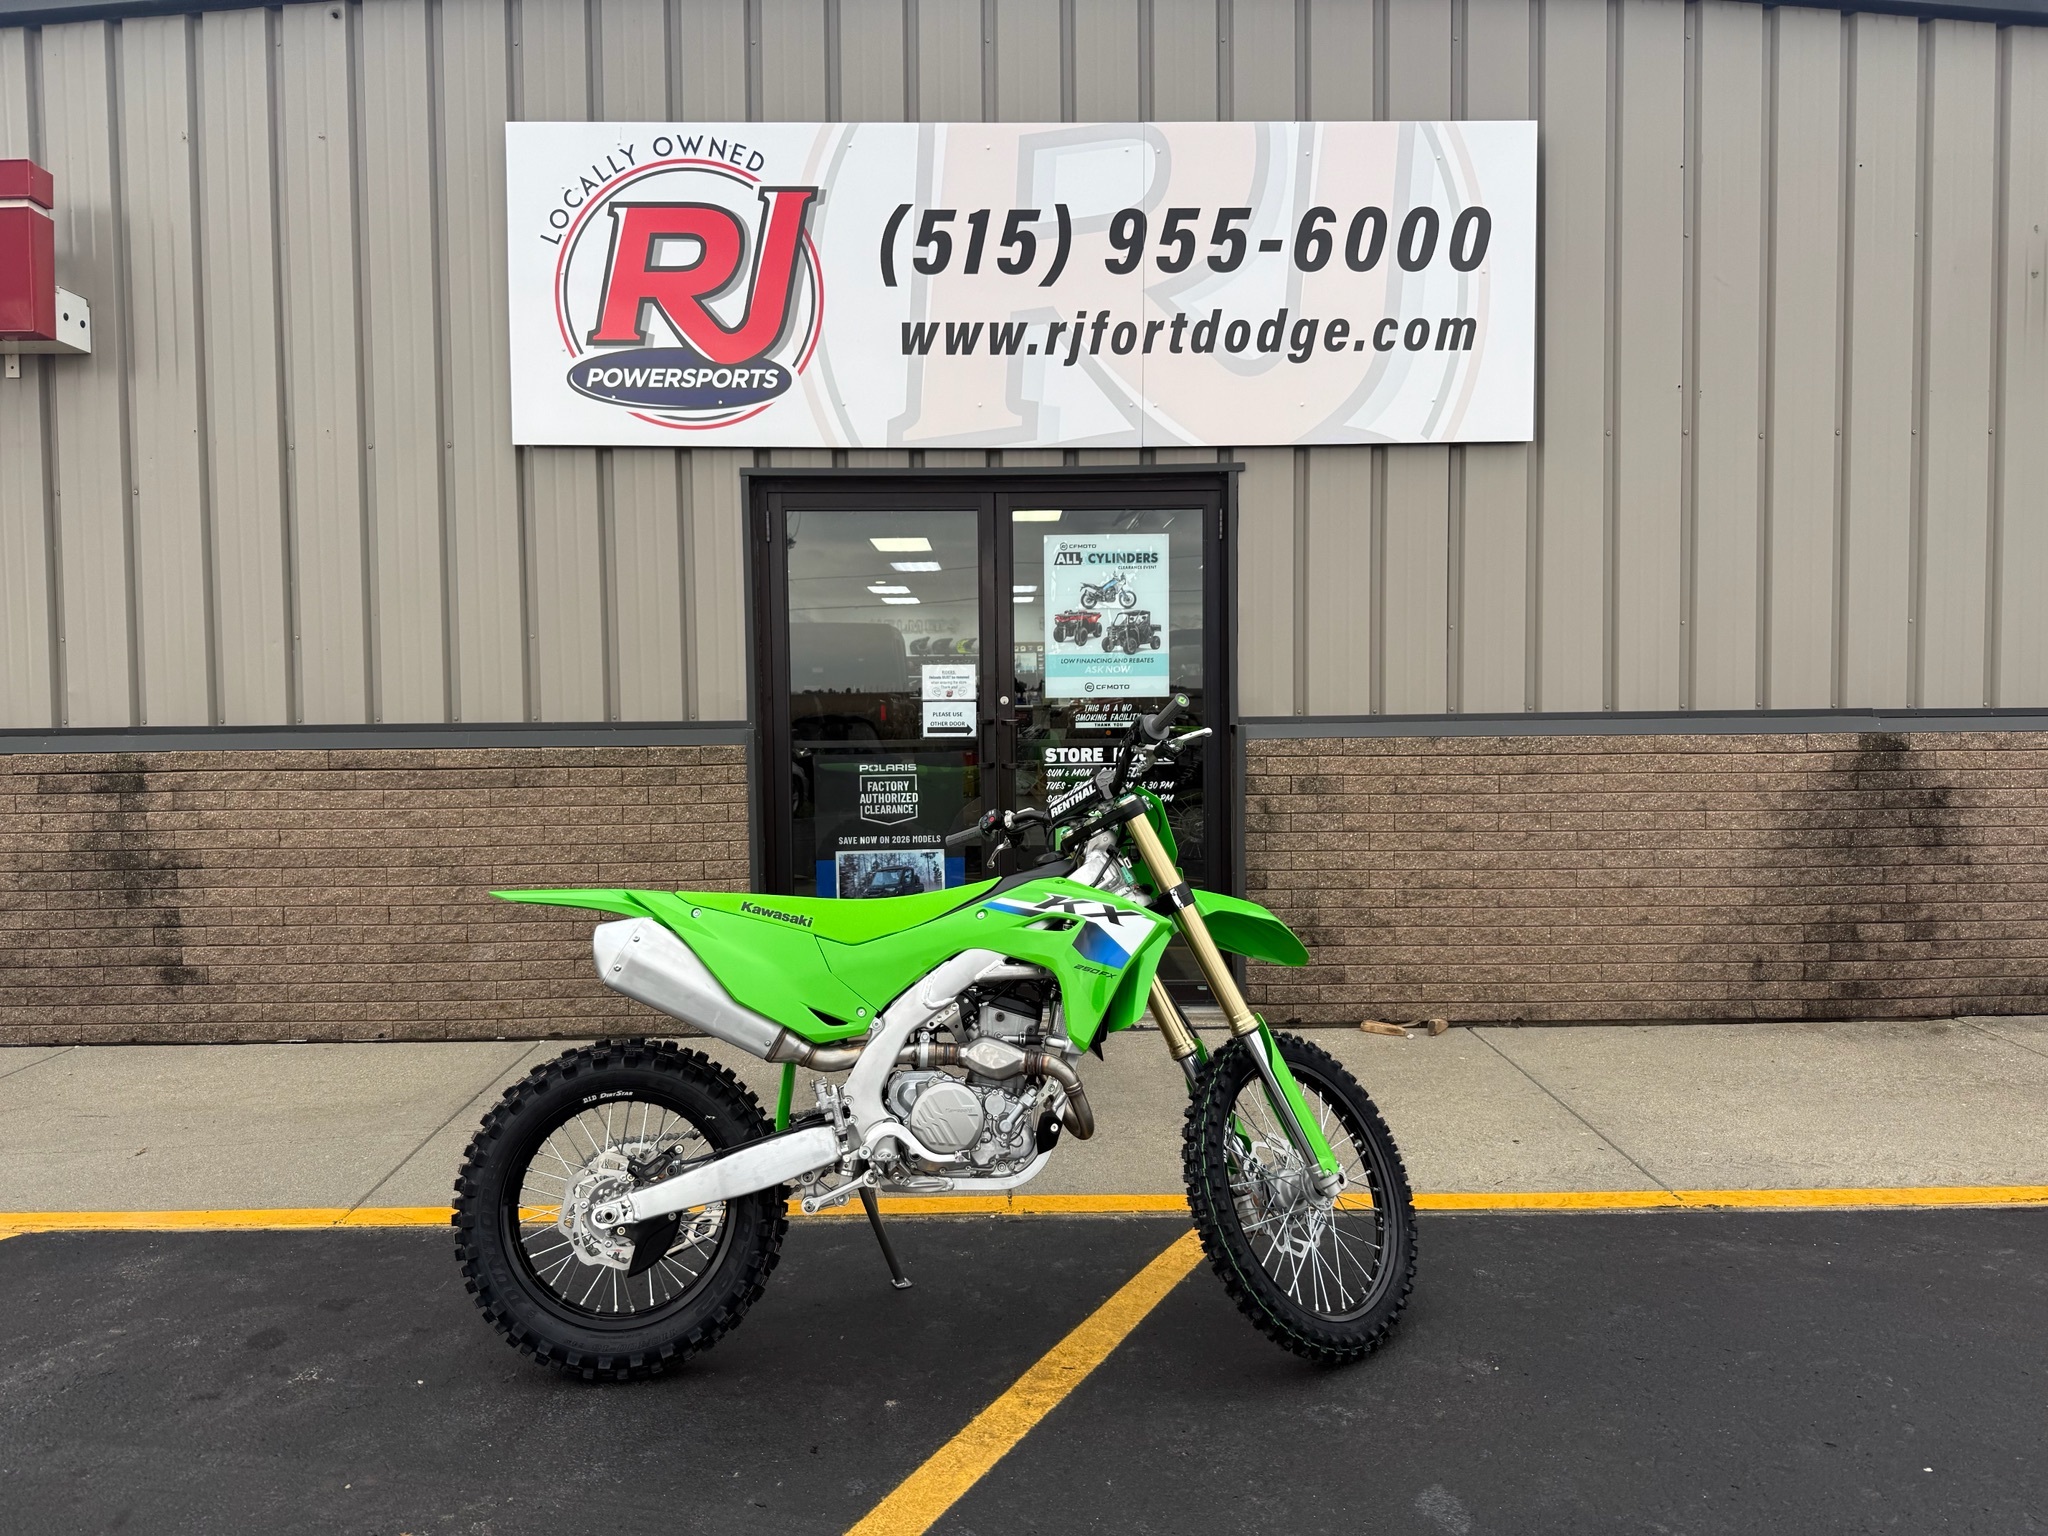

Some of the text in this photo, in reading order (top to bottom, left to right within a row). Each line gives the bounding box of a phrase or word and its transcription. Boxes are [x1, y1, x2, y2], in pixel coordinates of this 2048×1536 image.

[540, 134, 765, 245] LOCALLY OWNED
[880, 203, 1492, 287] (515) 955-6000
[586, 186, 819, 365] RJ
[900, 308, 1477, 366] www.rjfortdodge.com
[586, 367, 780, 390] POWERSPORTS
[1056, 552, 1159, 565] ALL CYLINDERS
[1085, 665, 1131, 674] ASK NOW
[1084, 703, 1133, 712] THIS IS A NO
[1075, 713, 1107, 721] SMOKING
[1045, 747, 1104, 763] STORE
[859, 763, 917, 772] POLARIS
[1046, 768, 1065, 777] SUN
[1071, 768, 1093, 777] MON
[867, 781, 909, 791] FACTORY
[1046, 781, 1066, 790] TUES
[1159, 780, 1175, 790] PM
[859, 792, 919, 804] AUTHORIZED
[1050, 784, 1096, 818] RENTHAL
[864, 804, 914, 815] CLEARANCE
[838, 835, 942, 845] SAVE NOW ON 2026 MODELS
[740, 901, 814, 928] Kawasaki
[1034, 895, 1144, 927] KX
